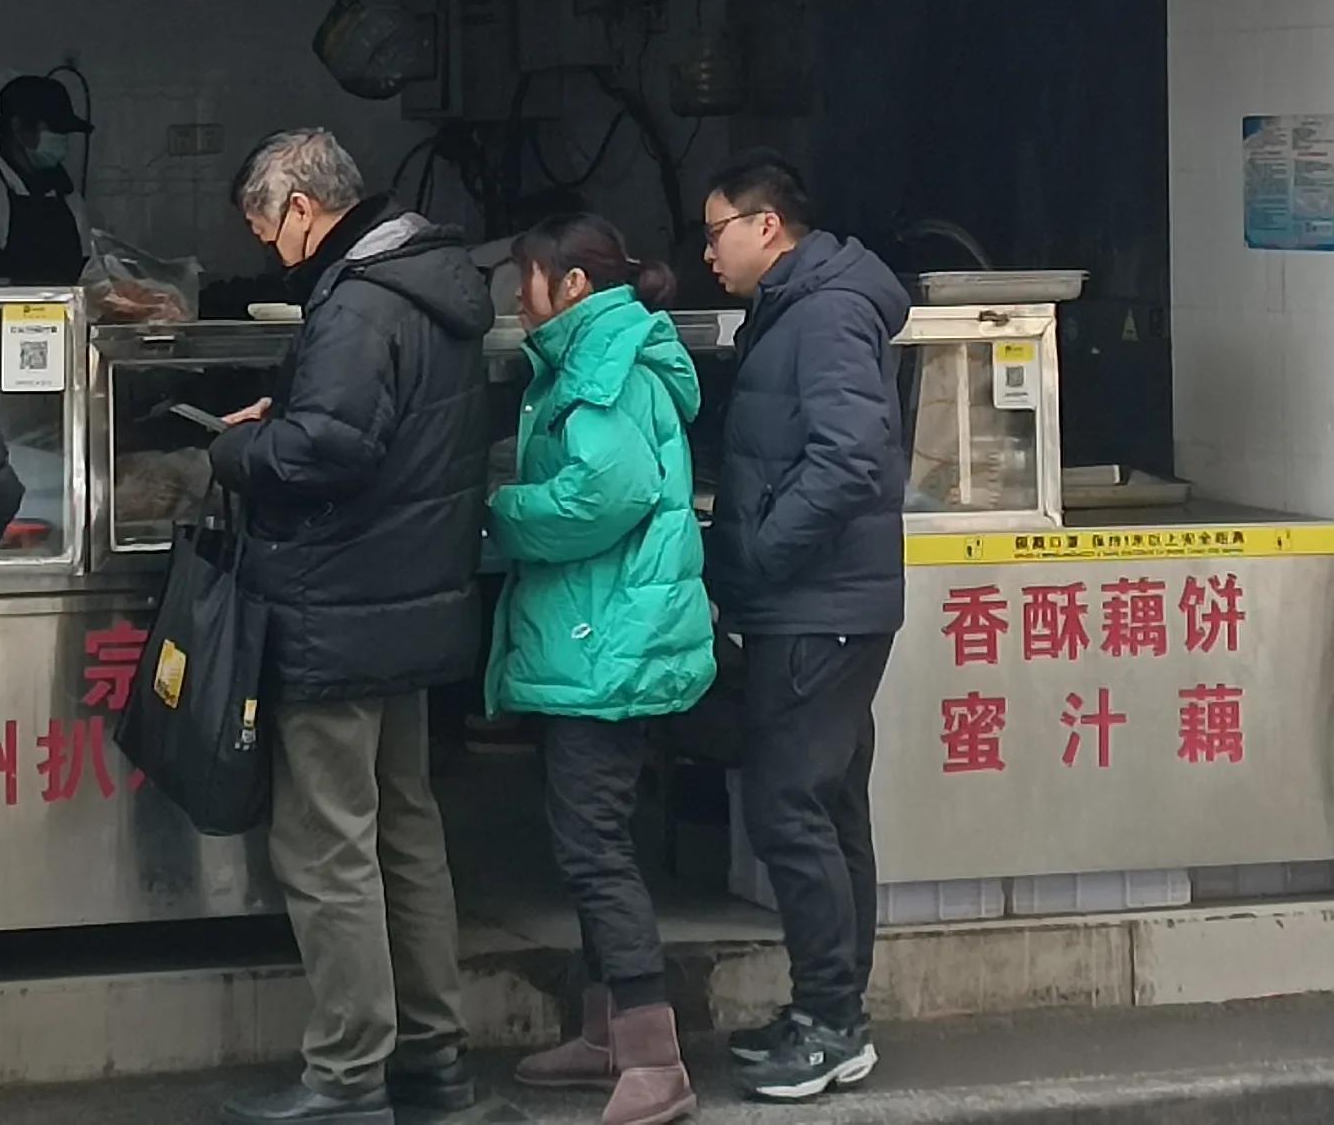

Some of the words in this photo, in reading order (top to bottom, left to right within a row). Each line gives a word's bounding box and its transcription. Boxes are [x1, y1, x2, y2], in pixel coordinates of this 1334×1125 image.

[941, 573, 1246, 666] 香酥藕饼
[940, 683, 1244, 774] 蜜汁藕
